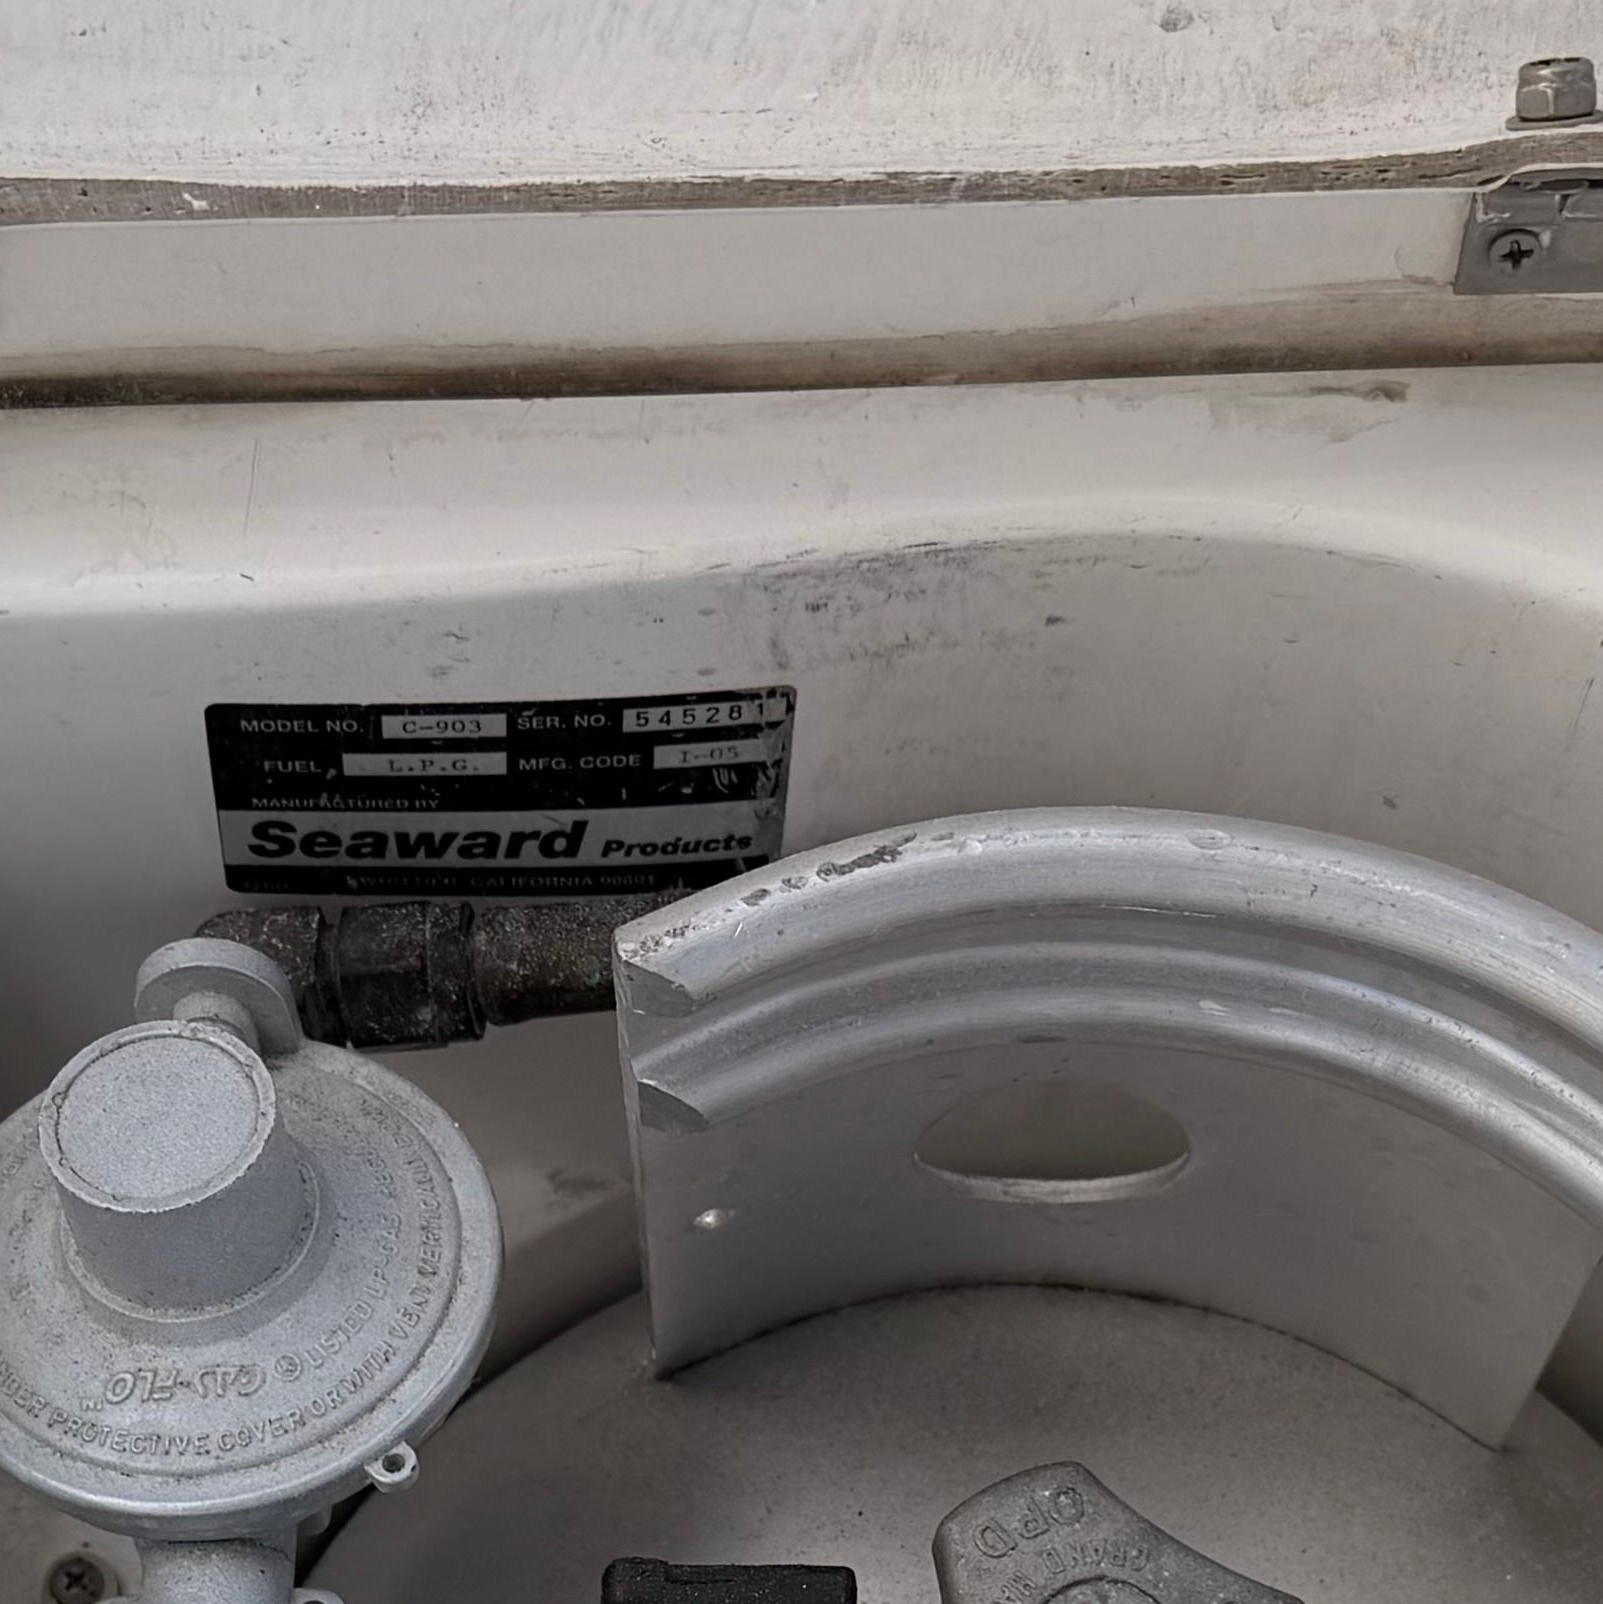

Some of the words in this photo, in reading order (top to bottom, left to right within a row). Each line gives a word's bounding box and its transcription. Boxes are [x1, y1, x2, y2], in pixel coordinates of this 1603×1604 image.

[240, 719, 320, 734] MODEL
[325, 719, 364, 734] NO.
[401, 719, 483, 736] C-903
[517, 714, 566, 730] SER.
[574, 713, 612, 728] NO.
[263, 760, 323, 773] FUEL
[388, 758, 480, 773] L.P.G.
[519, 756, 573, 771] MFG.
[580, 753, 643, 769] CODE
[247, 820, 589, 860] Seaward
[600, 834, 754, 858] Products
[303, 1298, 374, 1370] LISTED
[47, 1406, 212, 1456] PROTECTIVE
[217, 1407, 307, 1453] COVER
[308, 1387, 345, 1417] OR
[339, 1338, 399, 1396] WITH
[972, 1486, 1087, 1559] OPD
